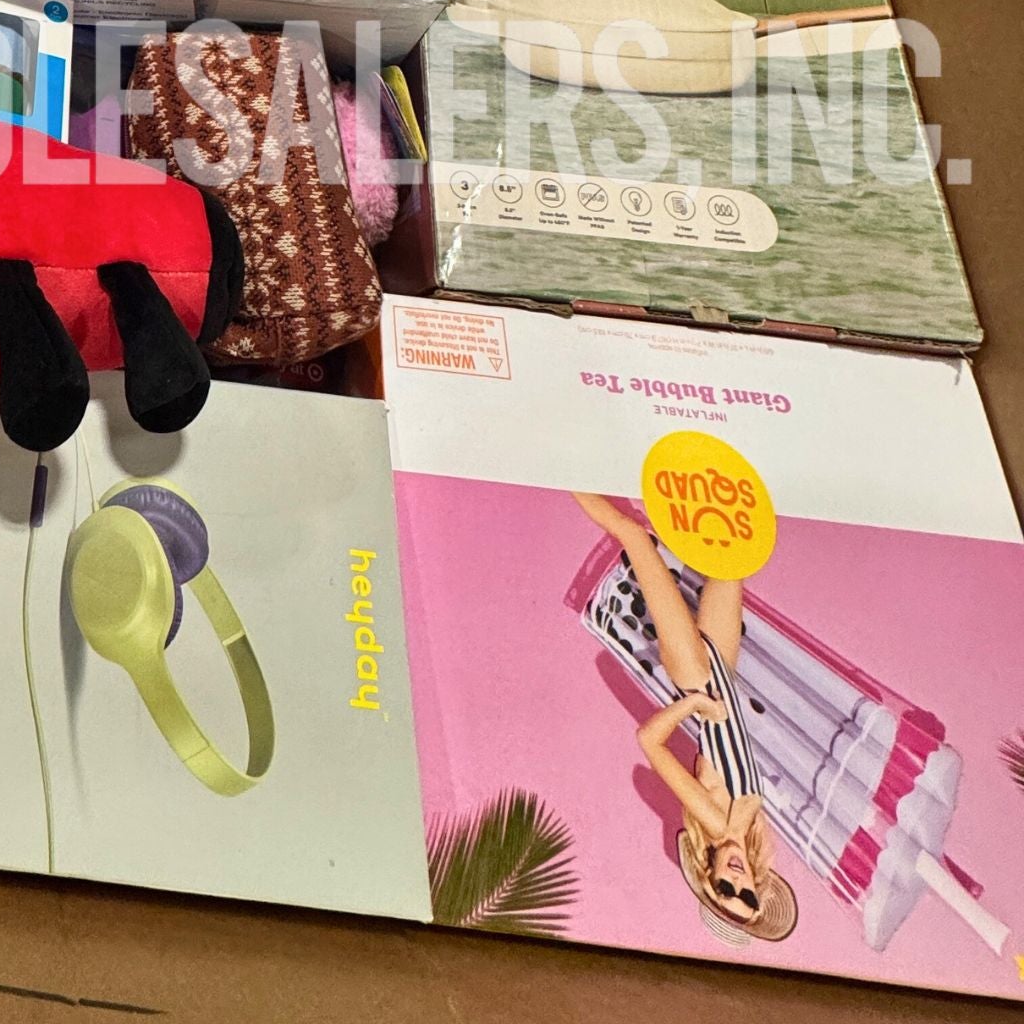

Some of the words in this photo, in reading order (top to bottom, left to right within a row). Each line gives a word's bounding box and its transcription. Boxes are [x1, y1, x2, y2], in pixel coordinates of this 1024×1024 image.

[52, 4, 61, 14] 2
[461, 180, 469, 190] 3
[401, 347, 475, 368] WARNING:
[486, 347, 500, 355] This
[580, 370, 625, 395] Tea
[627, 378, 717, 407] Bubble
[725, 386, 791, 414] Giant
[653, 404, 729, 422] INFLATABLE
[655, 468, 756, 509] SQUAD
[669, 503, 753, 541] SUN
[345, 548, 384, 711] heyday
